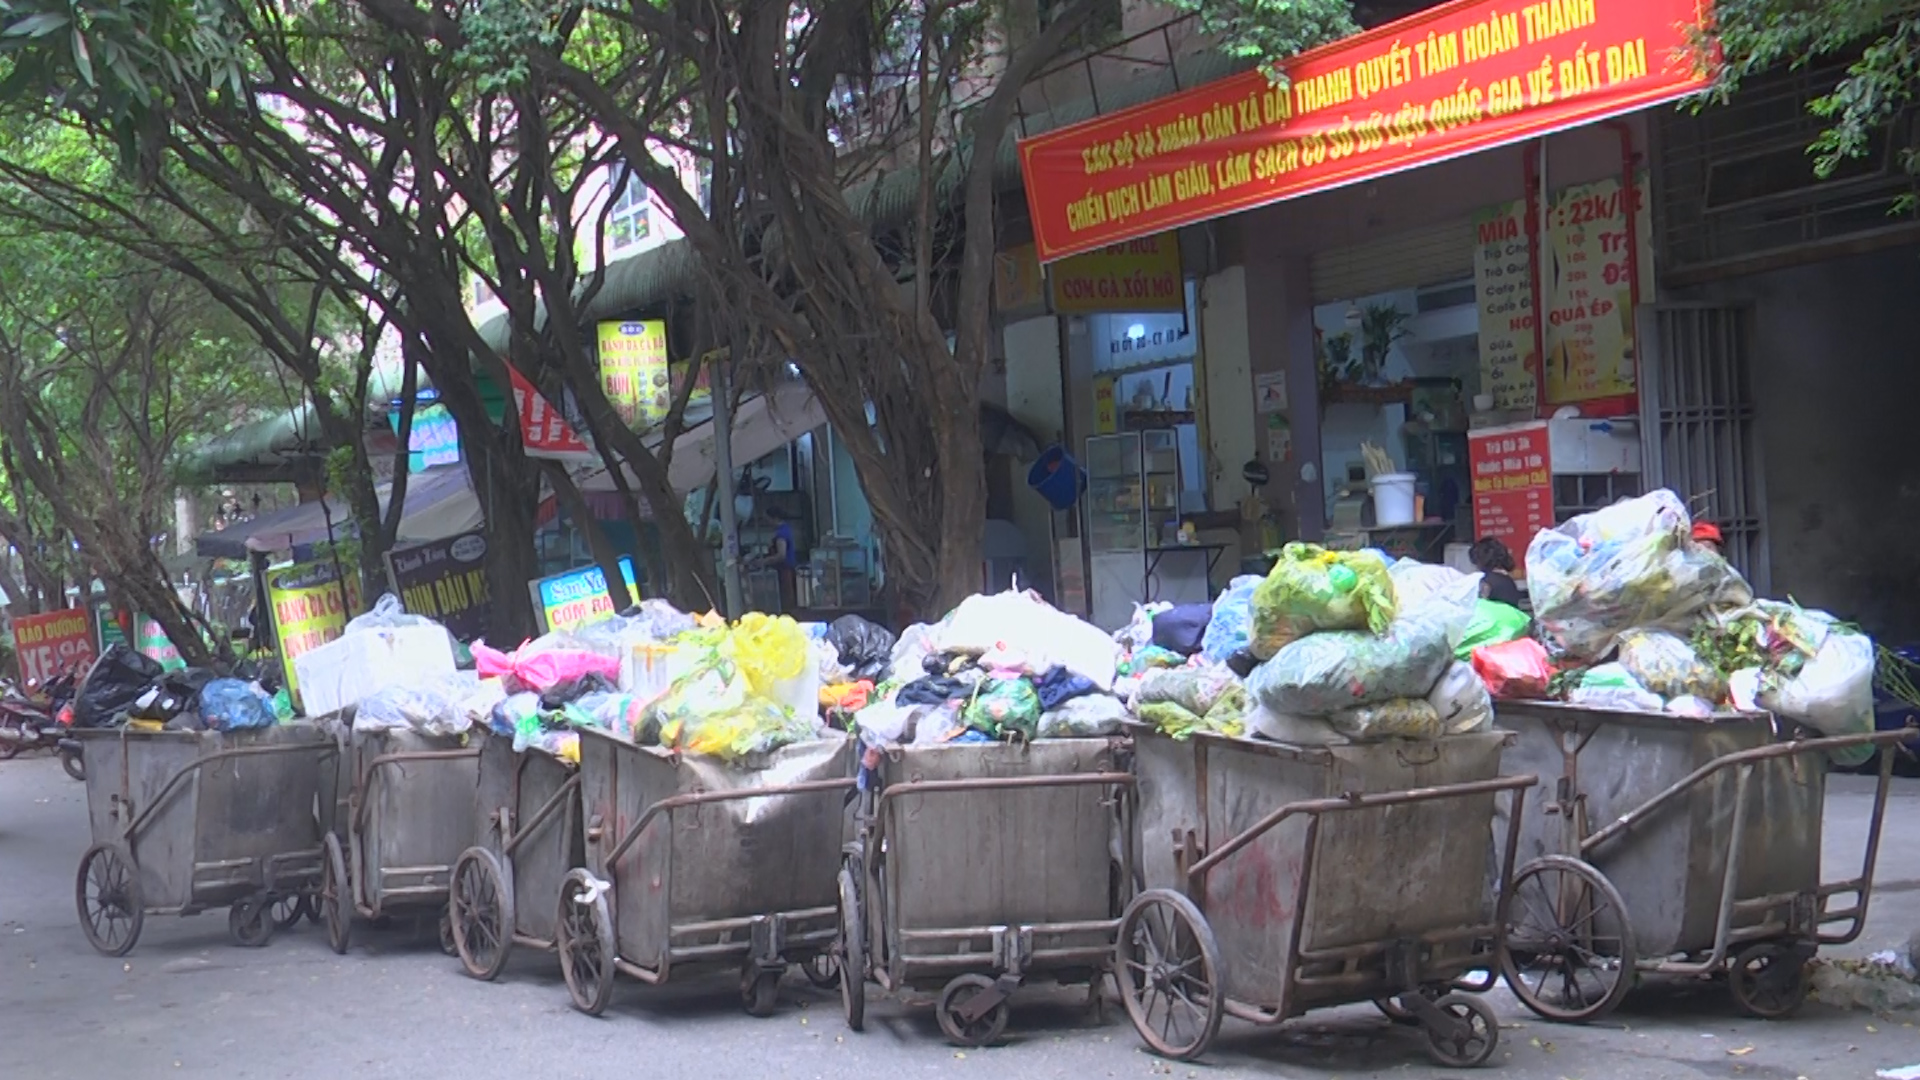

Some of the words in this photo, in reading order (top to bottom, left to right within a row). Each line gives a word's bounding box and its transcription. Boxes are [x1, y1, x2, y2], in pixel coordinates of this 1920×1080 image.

[1157, 114, 1200, 153] NHÂN
[1202, 103, 1236, 142] DÂN
[1295, 68, 1352, 115] THANH
[1356, 40, 1411, 99] QUYẾT
[1416, 32, 1459, 78] TÂM
[1463, 11, 1520, 64] HOÀN
[1067, 188, 1106, 232] CHIẾN
[1107, 184, 1140, 224] DỊCH
[1141, 174, 1173, 211] LÀM
[1217, 151, 1251, 190] LÀM
[1255, 140, 1298, 184] SẠCH
[1385, 103, 1426, 147] LIỆU
[1431, 79, 1483, 136] QUỐC
[1489, 77, 1523, 116] GIA
[1528, 55, 1555, 107] VỀ
[1560, 42, 1602, 99] ĐẤT
[1607, 39, 1648, 87] ĐAI
[1479, 213, 1518, 245] MÍA
[1591, 298, 1613, 317] ÉP
[436, 570, 469, 619] ĐẬU
